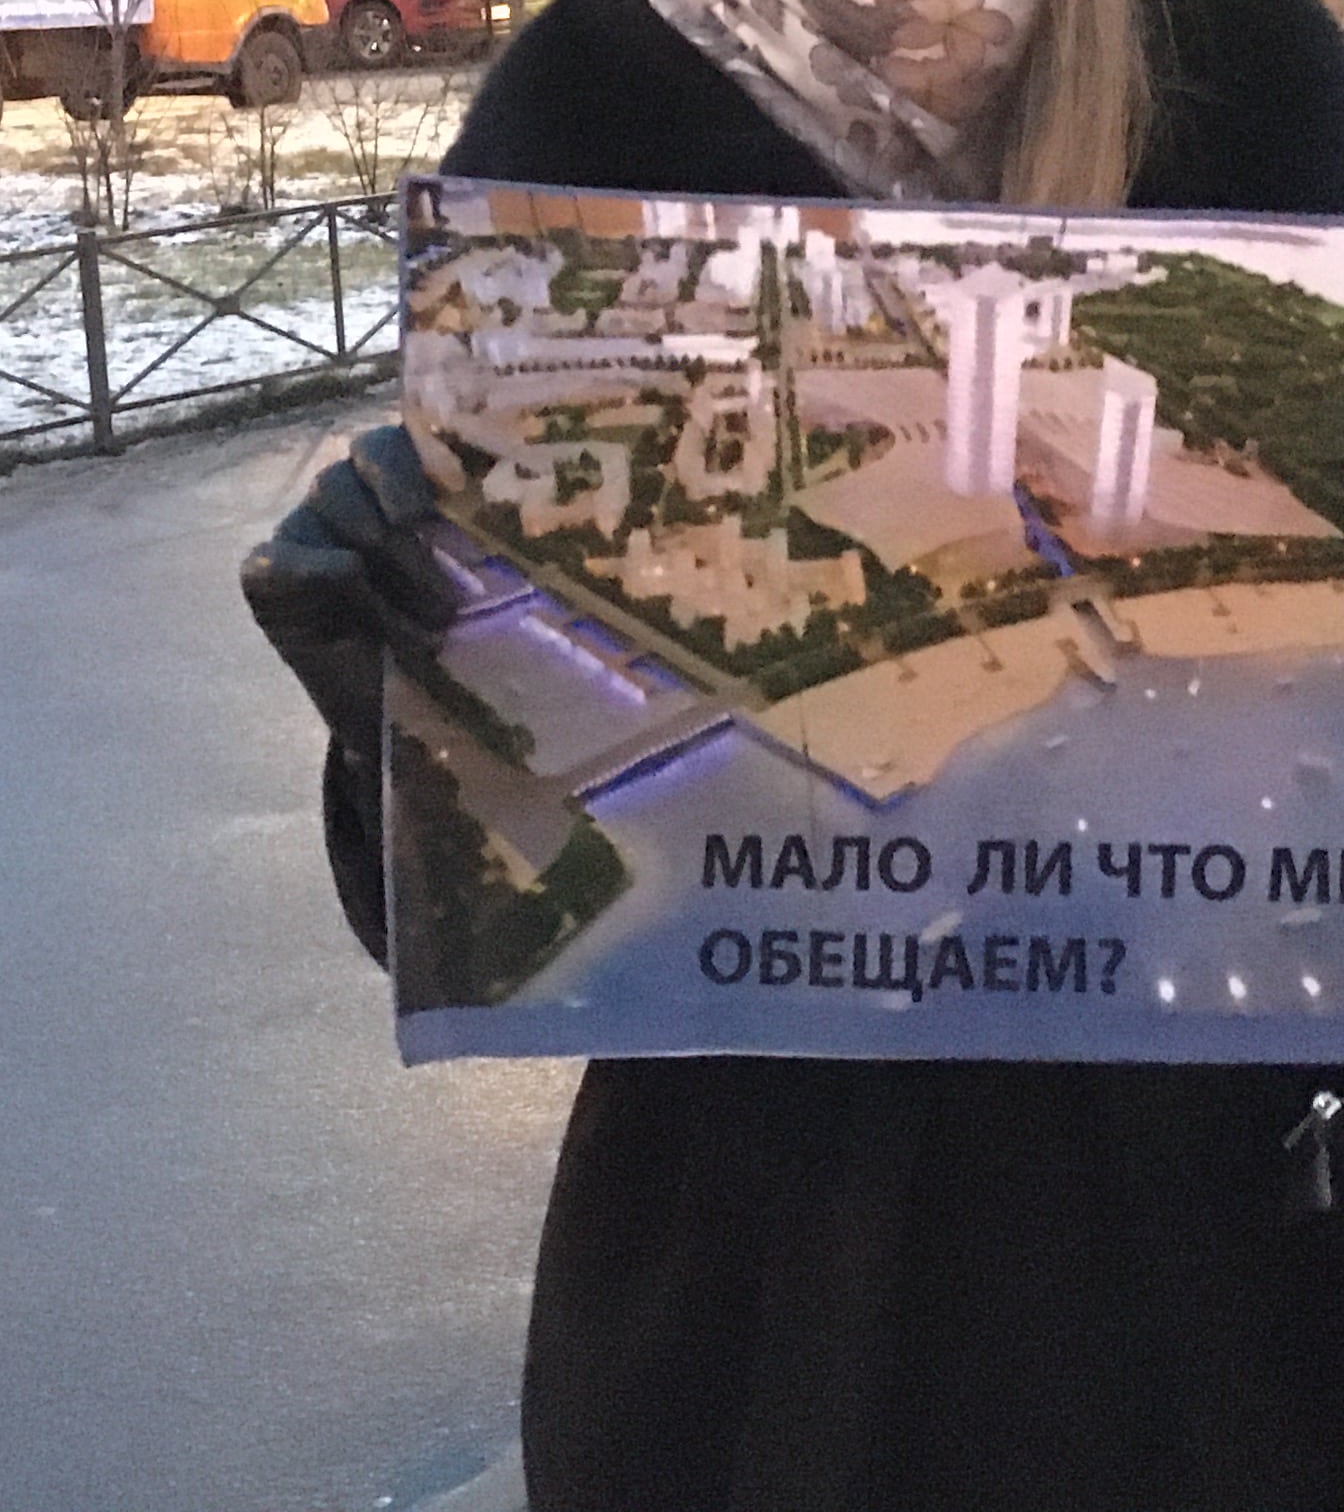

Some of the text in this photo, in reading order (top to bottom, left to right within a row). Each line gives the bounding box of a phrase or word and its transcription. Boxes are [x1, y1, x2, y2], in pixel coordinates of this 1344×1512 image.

[701, 833, 933, 893] МАЛО
[966, 837, 1074, 896] ЛИ
[1096, 841, 1248, 901] ЧТО
[698, 928, 1128, 1003] ОБЕЩАЕМ?
